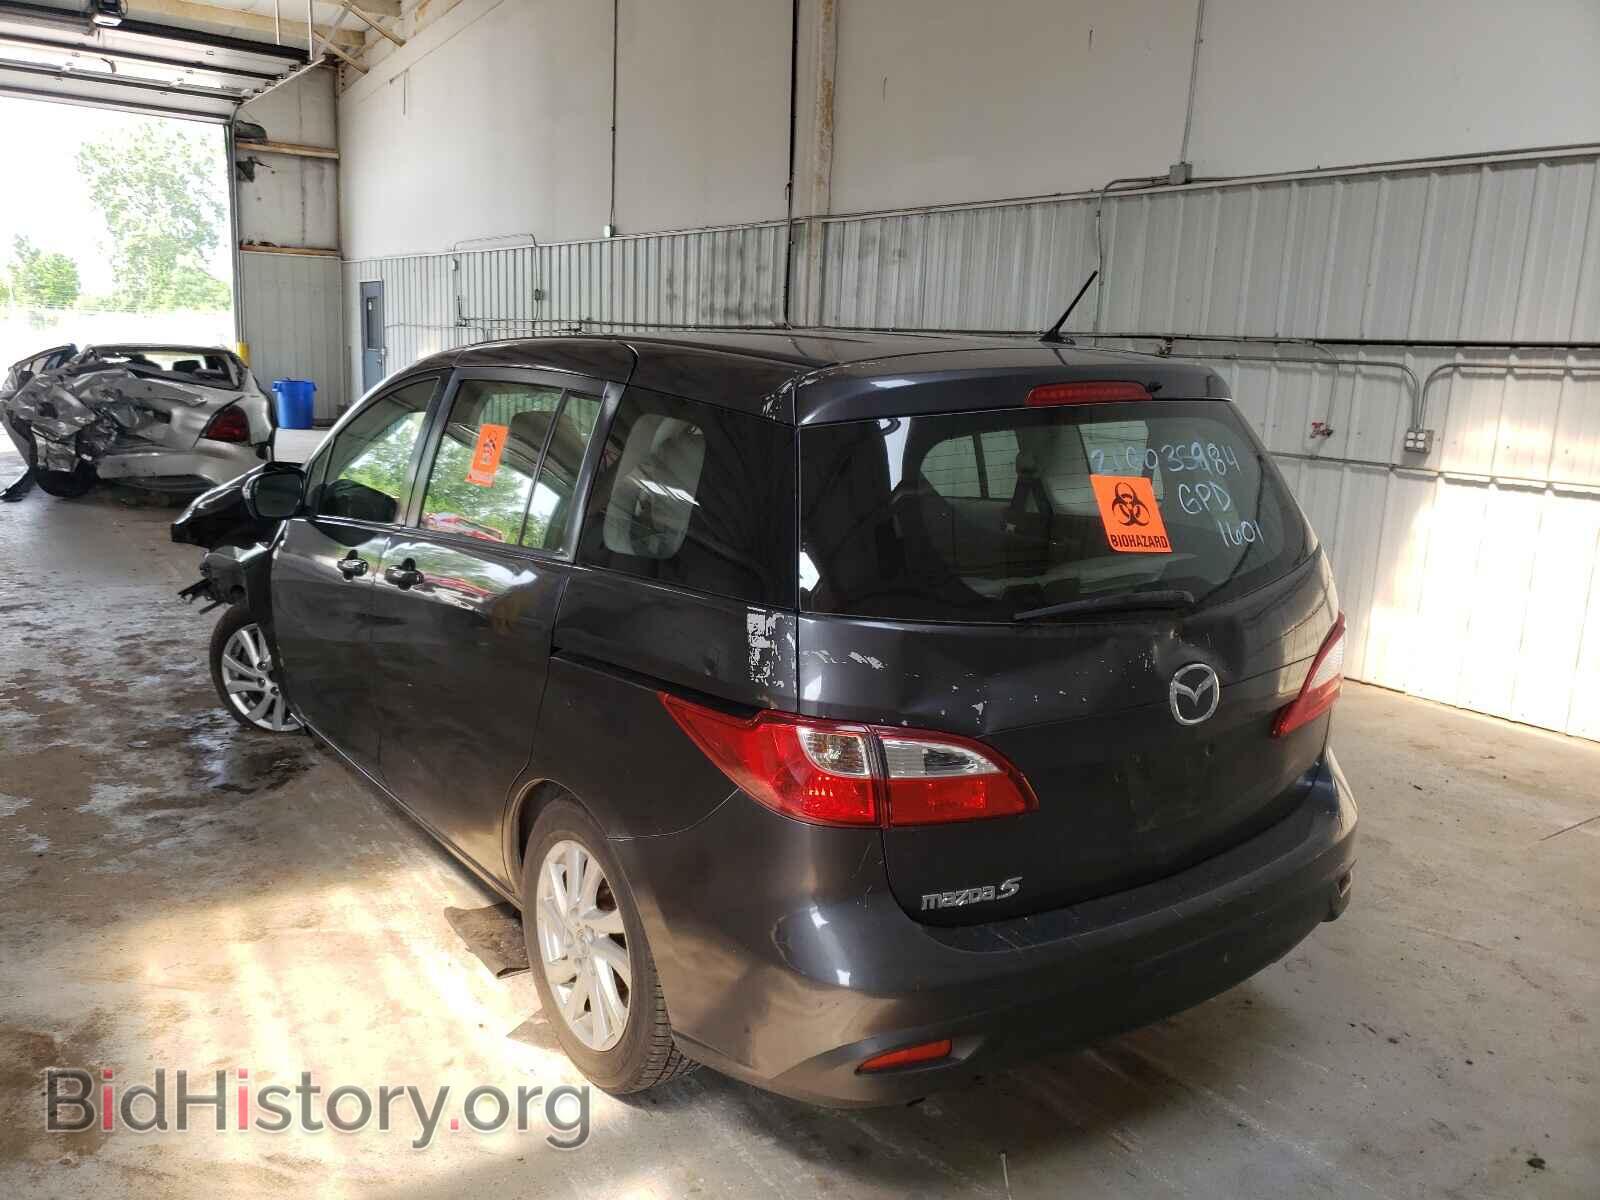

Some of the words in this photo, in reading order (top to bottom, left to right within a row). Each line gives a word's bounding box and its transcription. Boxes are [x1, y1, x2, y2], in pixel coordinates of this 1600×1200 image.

[1178, 480, 1231, 515] GPD
[1110, 533, 1169, 549] BIOHAZARD
[1217, 519, 1264, 548] 1601
